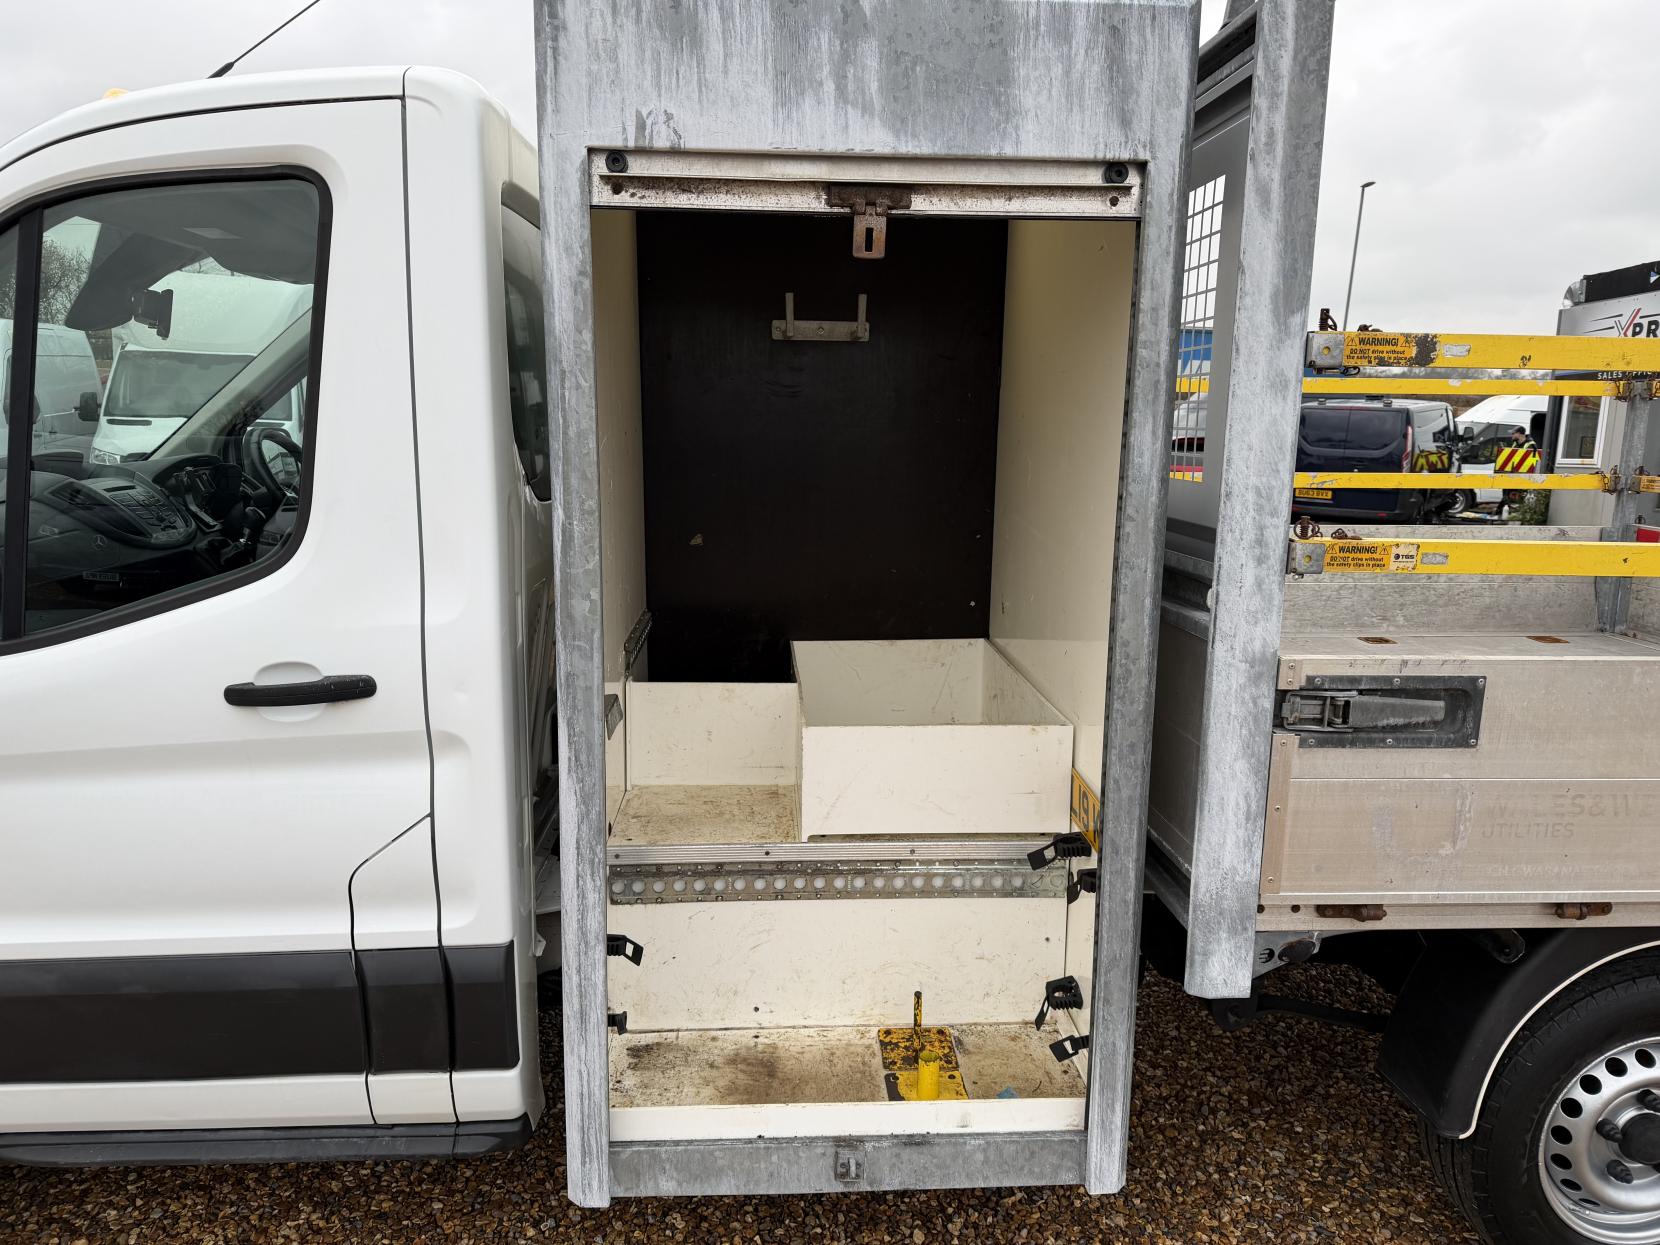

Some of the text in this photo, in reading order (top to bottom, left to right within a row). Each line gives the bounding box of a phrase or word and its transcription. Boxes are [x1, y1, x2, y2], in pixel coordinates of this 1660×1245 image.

[1358, 337, 1399, 347] WARNING!
[1597, 371, 1623, 380] SALES
[1338, 545, 1378, 555] WARNING!
[1481, 822, 1576, 839] UTILITIES
